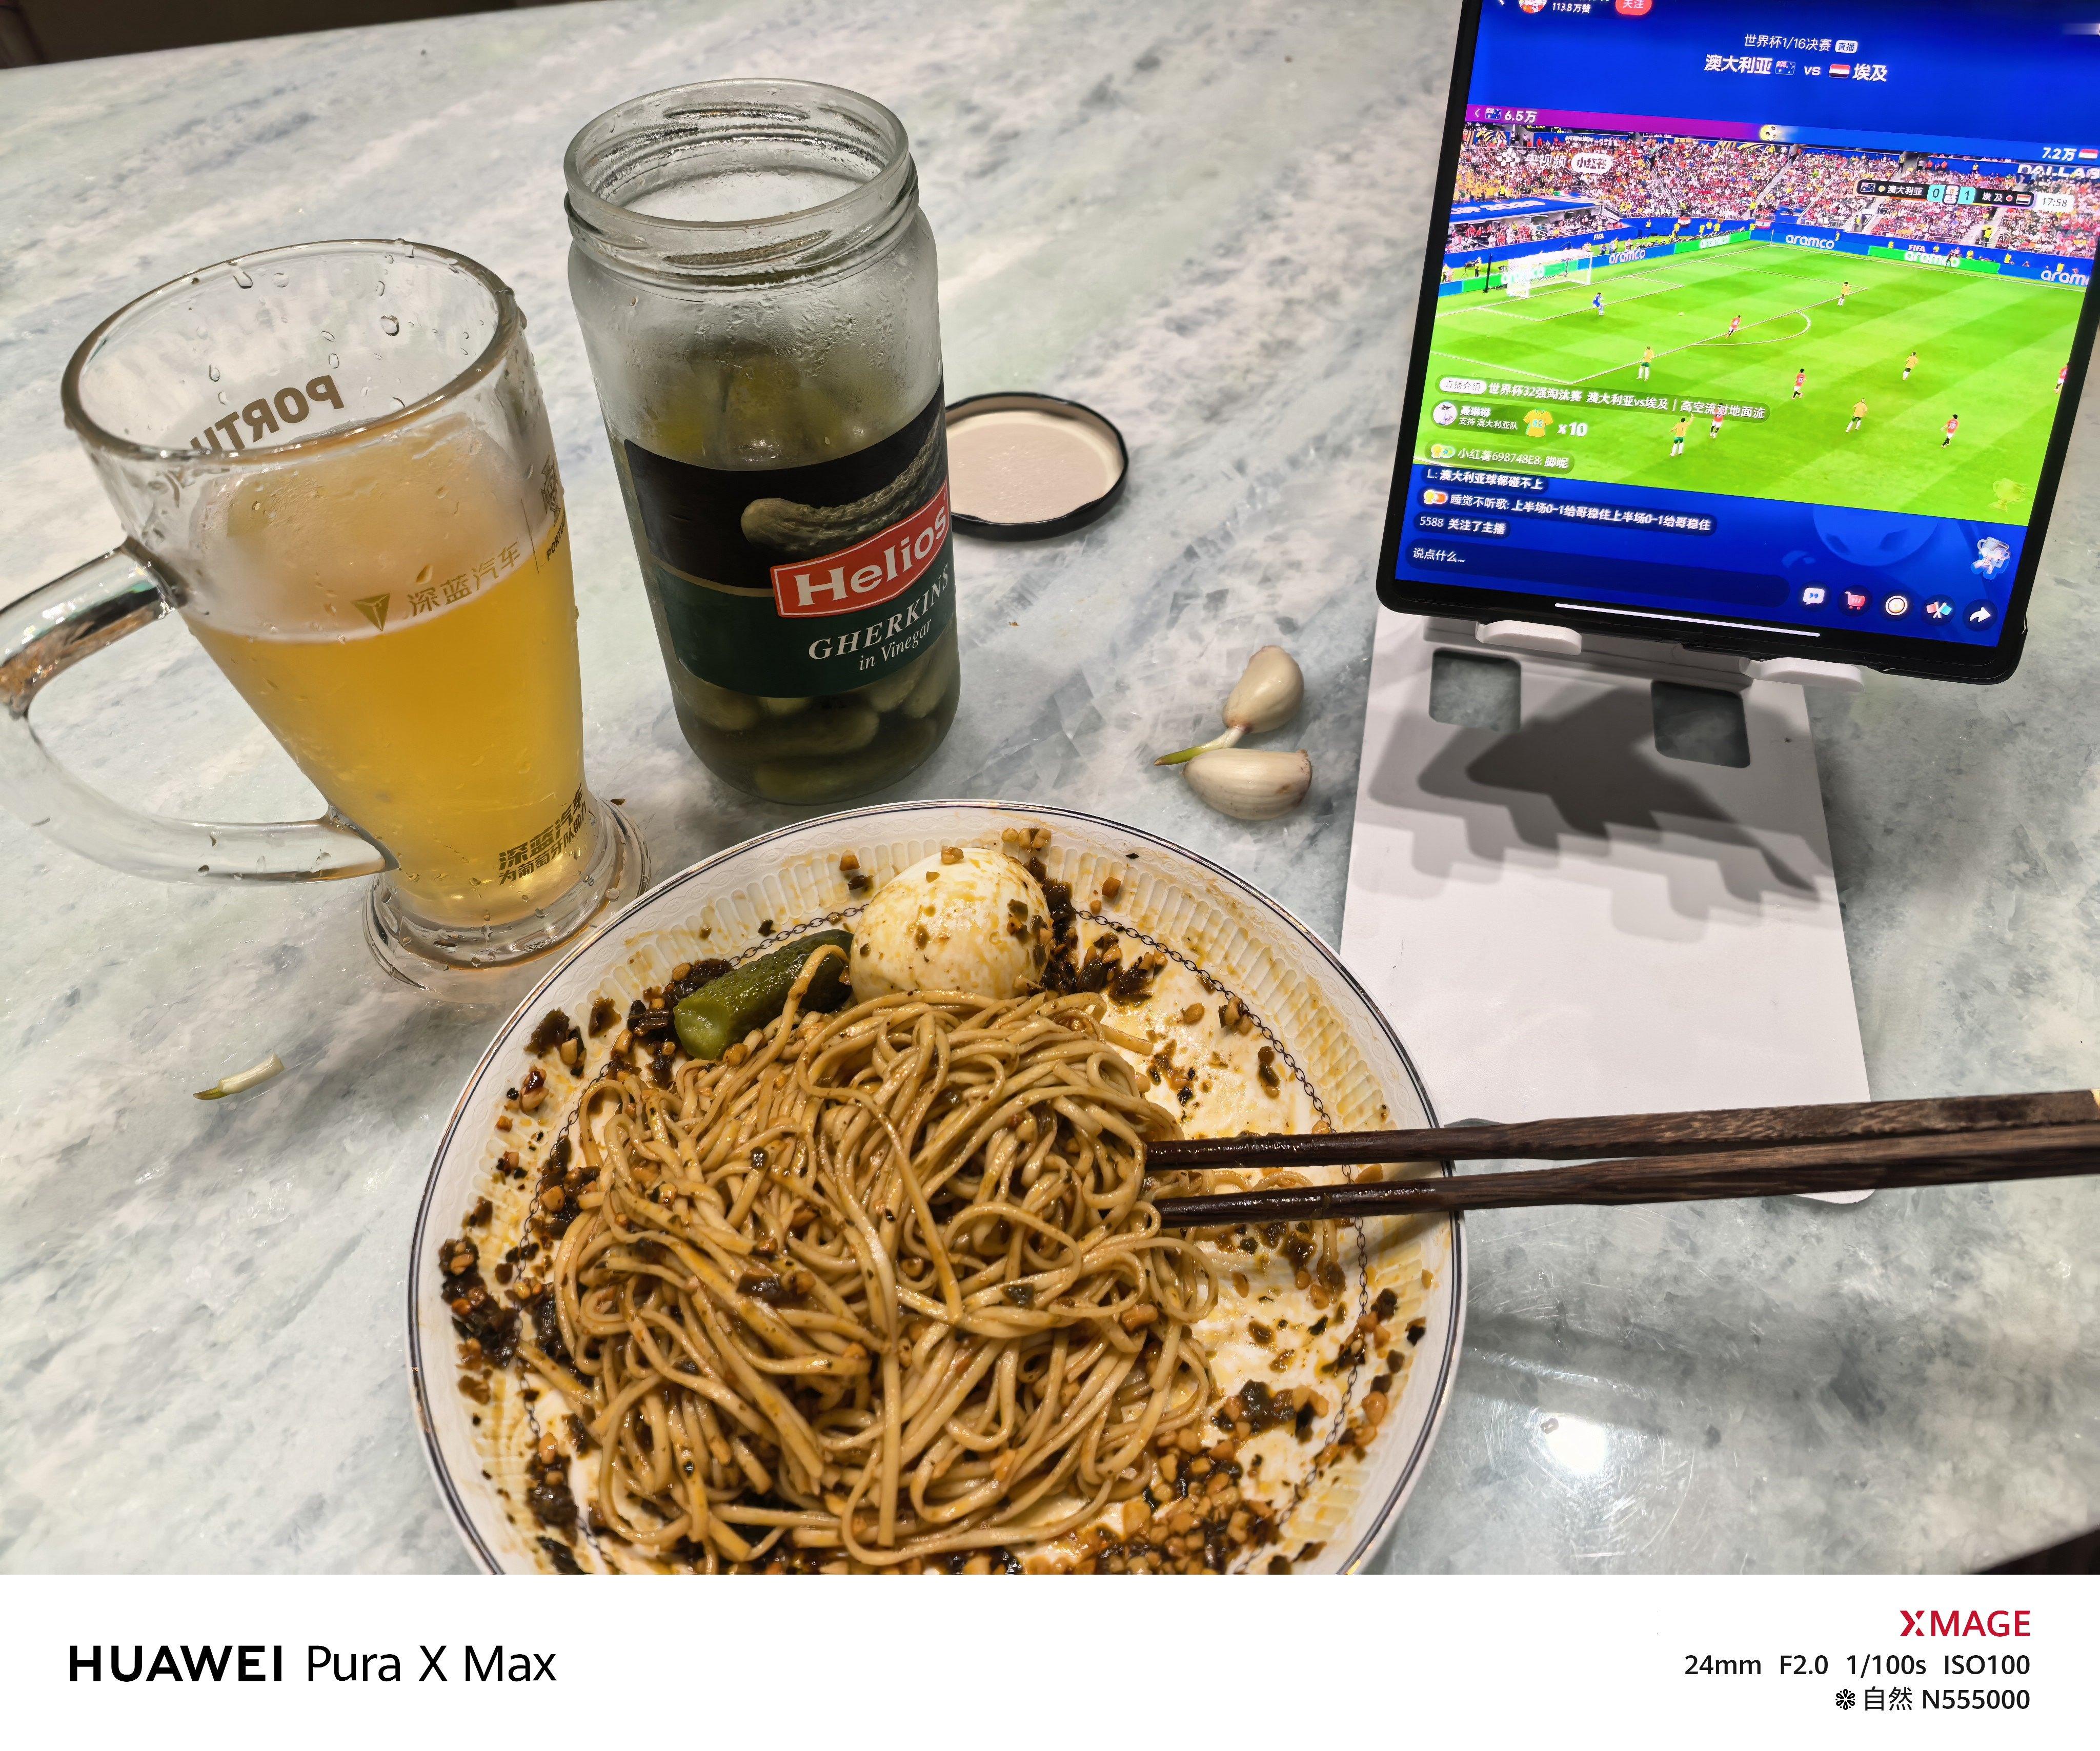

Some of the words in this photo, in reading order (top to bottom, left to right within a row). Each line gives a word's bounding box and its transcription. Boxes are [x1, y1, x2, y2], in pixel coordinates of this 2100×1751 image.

[1623, 0, 1644, 9] 关注
[1744, 33, 1832, 52] 世界杯1/16决赛
[1838, 41, 1855, 52] 直播
[1704, 54, 1773, 74] 澳大利亚
[1852, 64, 1887, 82] 埃及
[1504, 110, 1537, 124] 6.5万
[2042, 147, 2077, 161] 7.2万
[1577, 157, 1608, 170] 小红书
[1887, 185, 1923, 196] 澳大利亚
[1932, 188, 1940, 198] 0
[1964, 191, 1970, 200] 1
[1982, 192, 2003, 202] 埃及
[2042, 198, 2068, 207] 17:58
[1699, 235, 1730, 249] aramco
[1785, 234, 1834, 250] aramco
[1608, 249, 1646, 264] aramco
[1488, 382, 1583, 402] 世界杯32强淘汰赛
[1458, 417, 1476, 426] 支持
[1477, 418, 1518, 430] 澳大利亚队
[1544, 455, 1569, 469] 脚呢
[1439, 470, 1544, 490] 澳大利亚球都碰不上
[1419, 516, 1444, 527] 5588
[1447, 518, 1507, 535] 关注了主播
[794, 505, 946, 606] Helios
[407, 541, 521, 617] 深蓝汽车
[809, 563, 948, 660] GHERKINS
[859, 655, 875, 671] in
[881, 618, 932, 662] Vinegar
